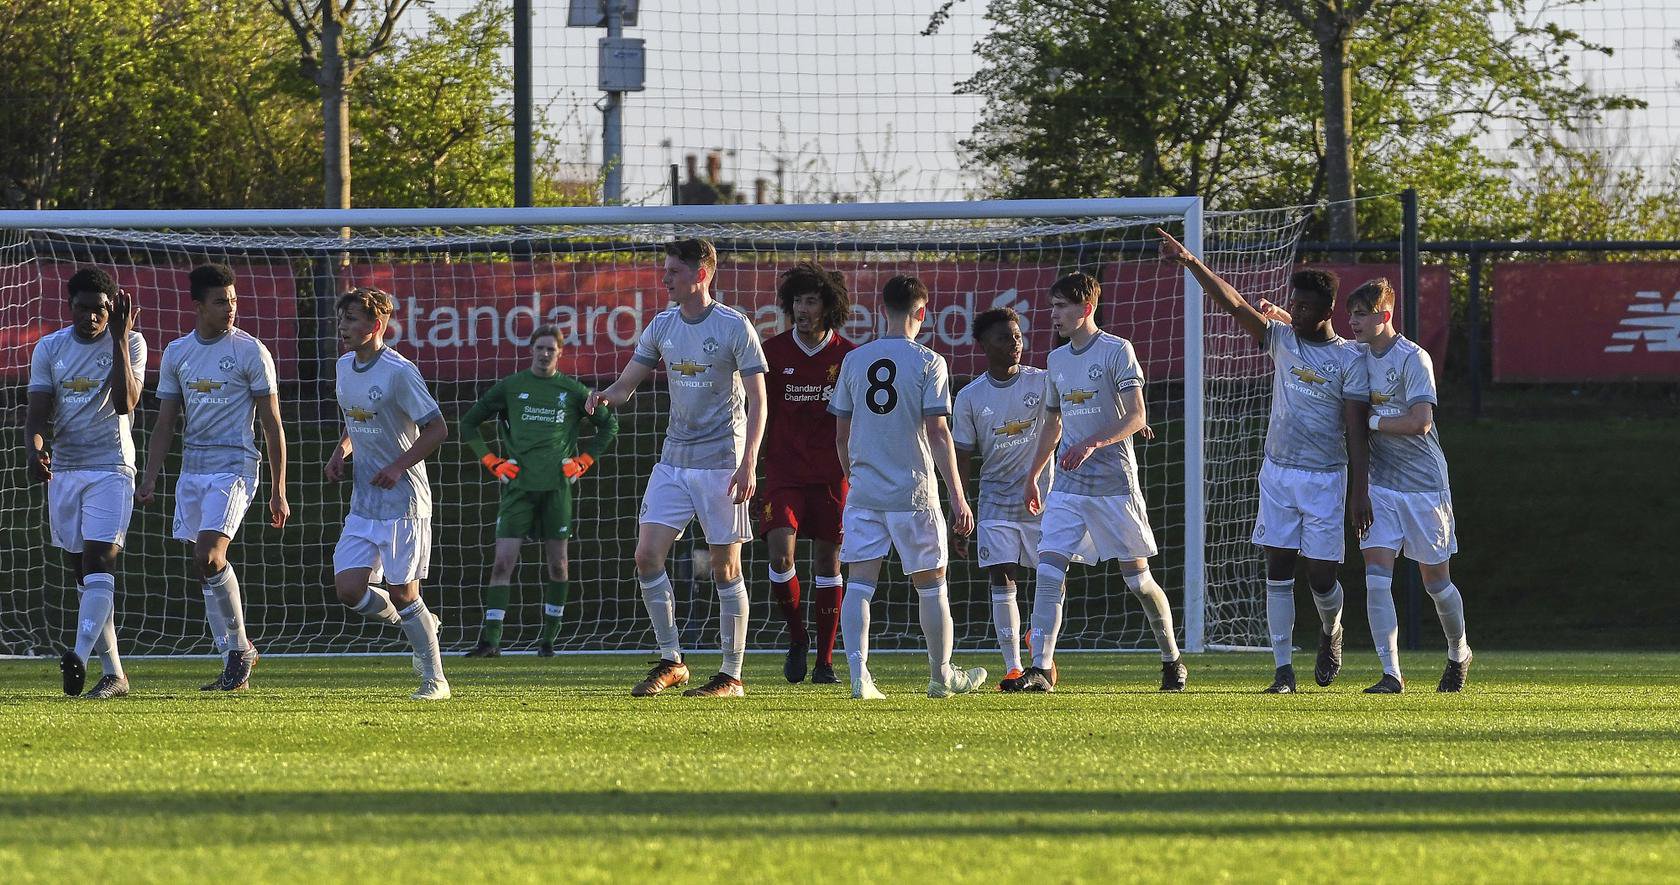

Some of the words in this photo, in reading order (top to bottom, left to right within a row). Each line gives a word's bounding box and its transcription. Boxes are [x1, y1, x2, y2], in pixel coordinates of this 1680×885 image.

[785, 384, 821, 393] Standard
[865, 358, 898, 415] 8
[784, 393, 820, 402] Chartered
[524, 405, 556, 415] Standard
[521, 413, 555, 423] Chartered
